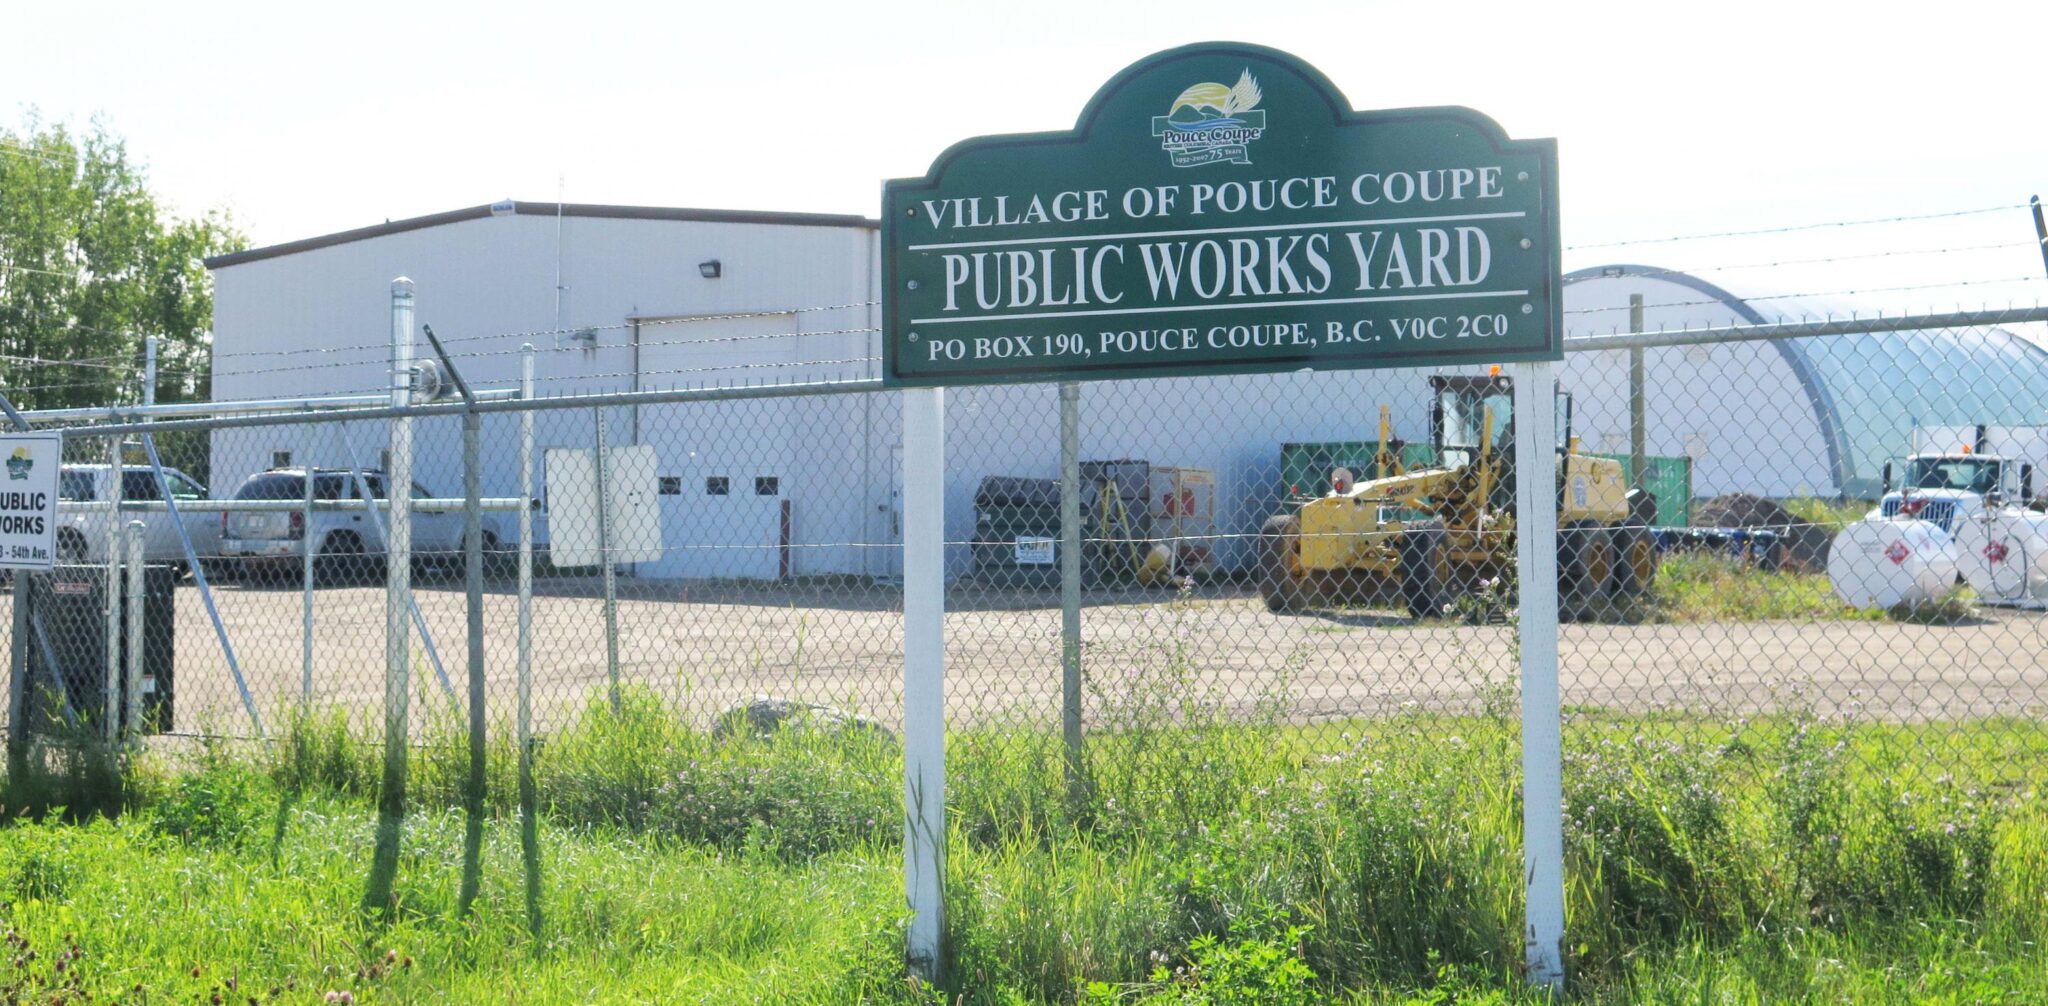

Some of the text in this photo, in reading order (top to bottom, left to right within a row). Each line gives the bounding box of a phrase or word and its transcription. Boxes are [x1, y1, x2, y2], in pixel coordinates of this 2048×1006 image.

[1163, 127, 1260, 143] Pouce Coupe
[1209, 148, 1223, 161] 75
[922, 166, 1504, 230] VILLAGE OF POUCE COUPE
[942, 226, 1492, 311] PUBLIC WORKS YARD
[928, 338, 966, 361] PO
[974, 335, 1034, 360] BOX
[1043, 333, 1091, 358] 190,
[1100, 328, 1199, 353] POUCE
[1207, 322, 1318, 349] COUPE,
[1326, 319, 1382, 343] B.C.
[0, 492, 46, 511] UBLIC
[0, 516, 44, 535] ORKS
[11, 545, 30, 559] 54th
[31, 546, 50, 560] Ave.
